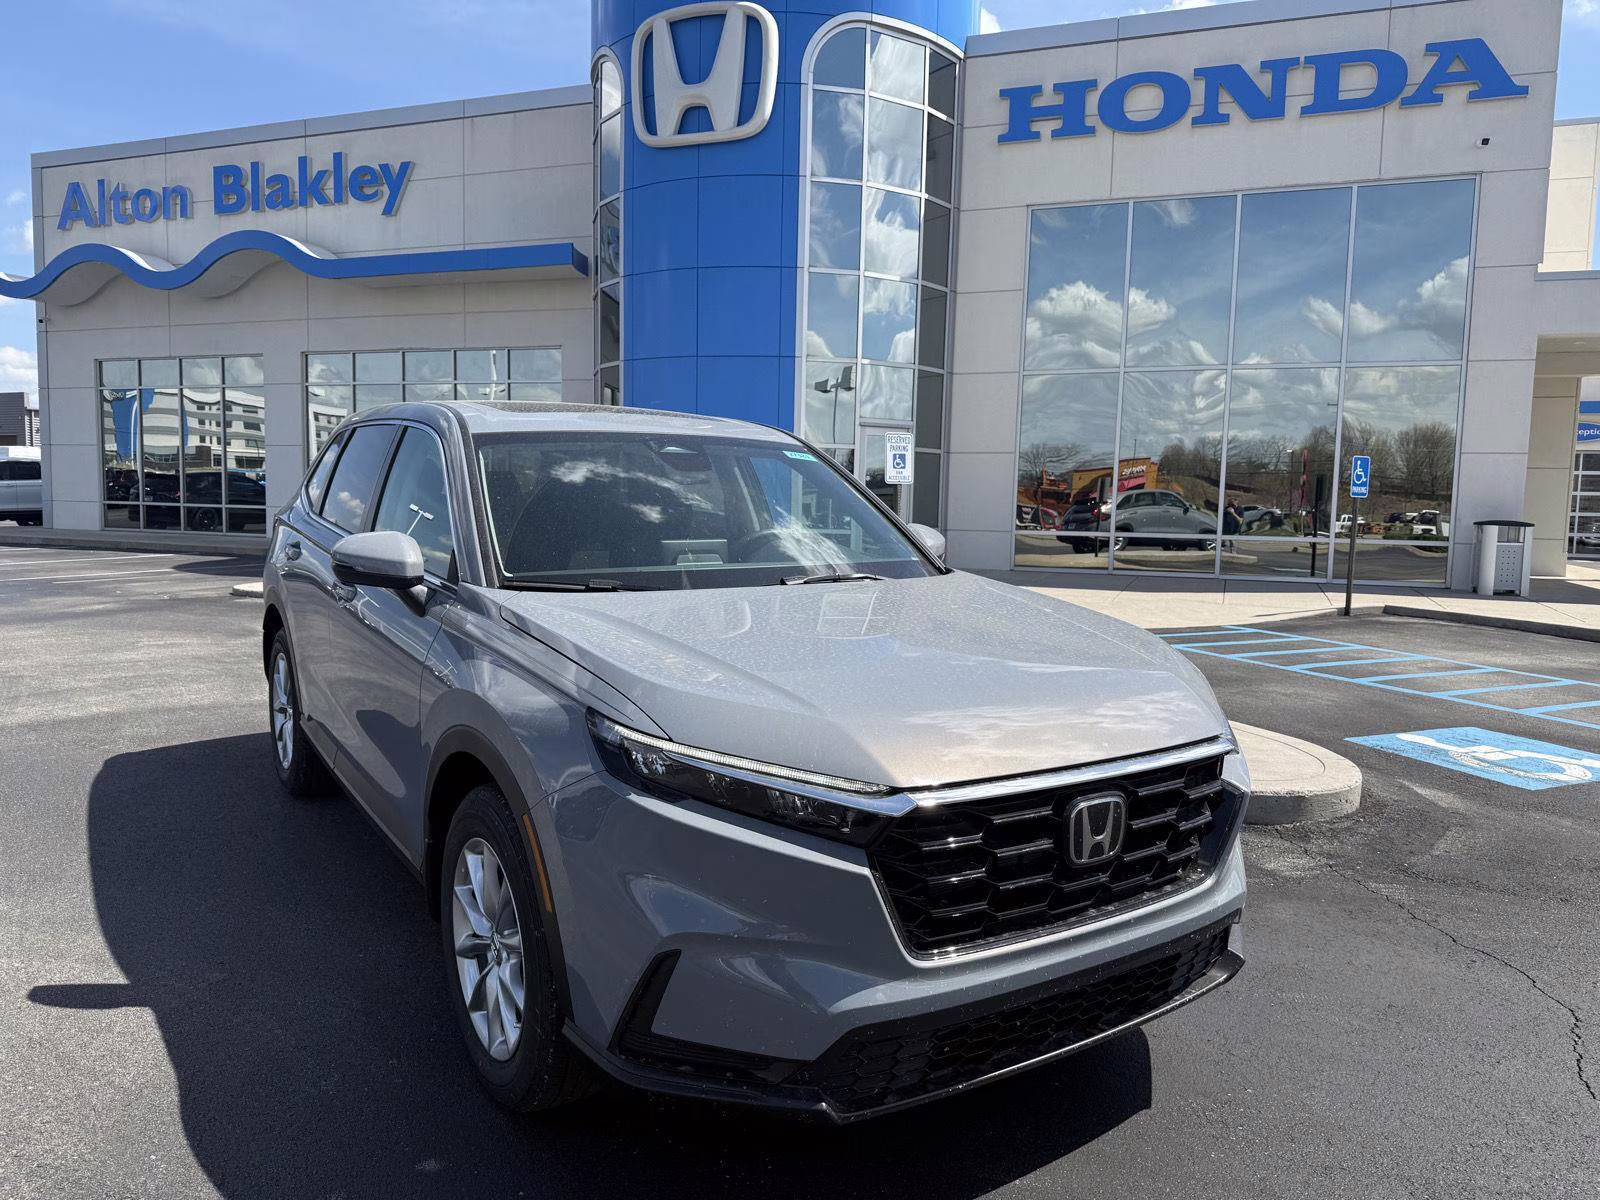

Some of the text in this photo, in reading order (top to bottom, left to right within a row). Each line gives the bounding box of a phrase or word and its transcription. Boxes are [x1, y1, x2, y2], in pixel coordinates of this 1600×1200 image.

[997, 37, 1529, 145] HONDA
[57, 151, 413, 231] Alton Blakley
[887, 435, 911, 444] RESERVED
[889, 444, 909, 452] PARKING
